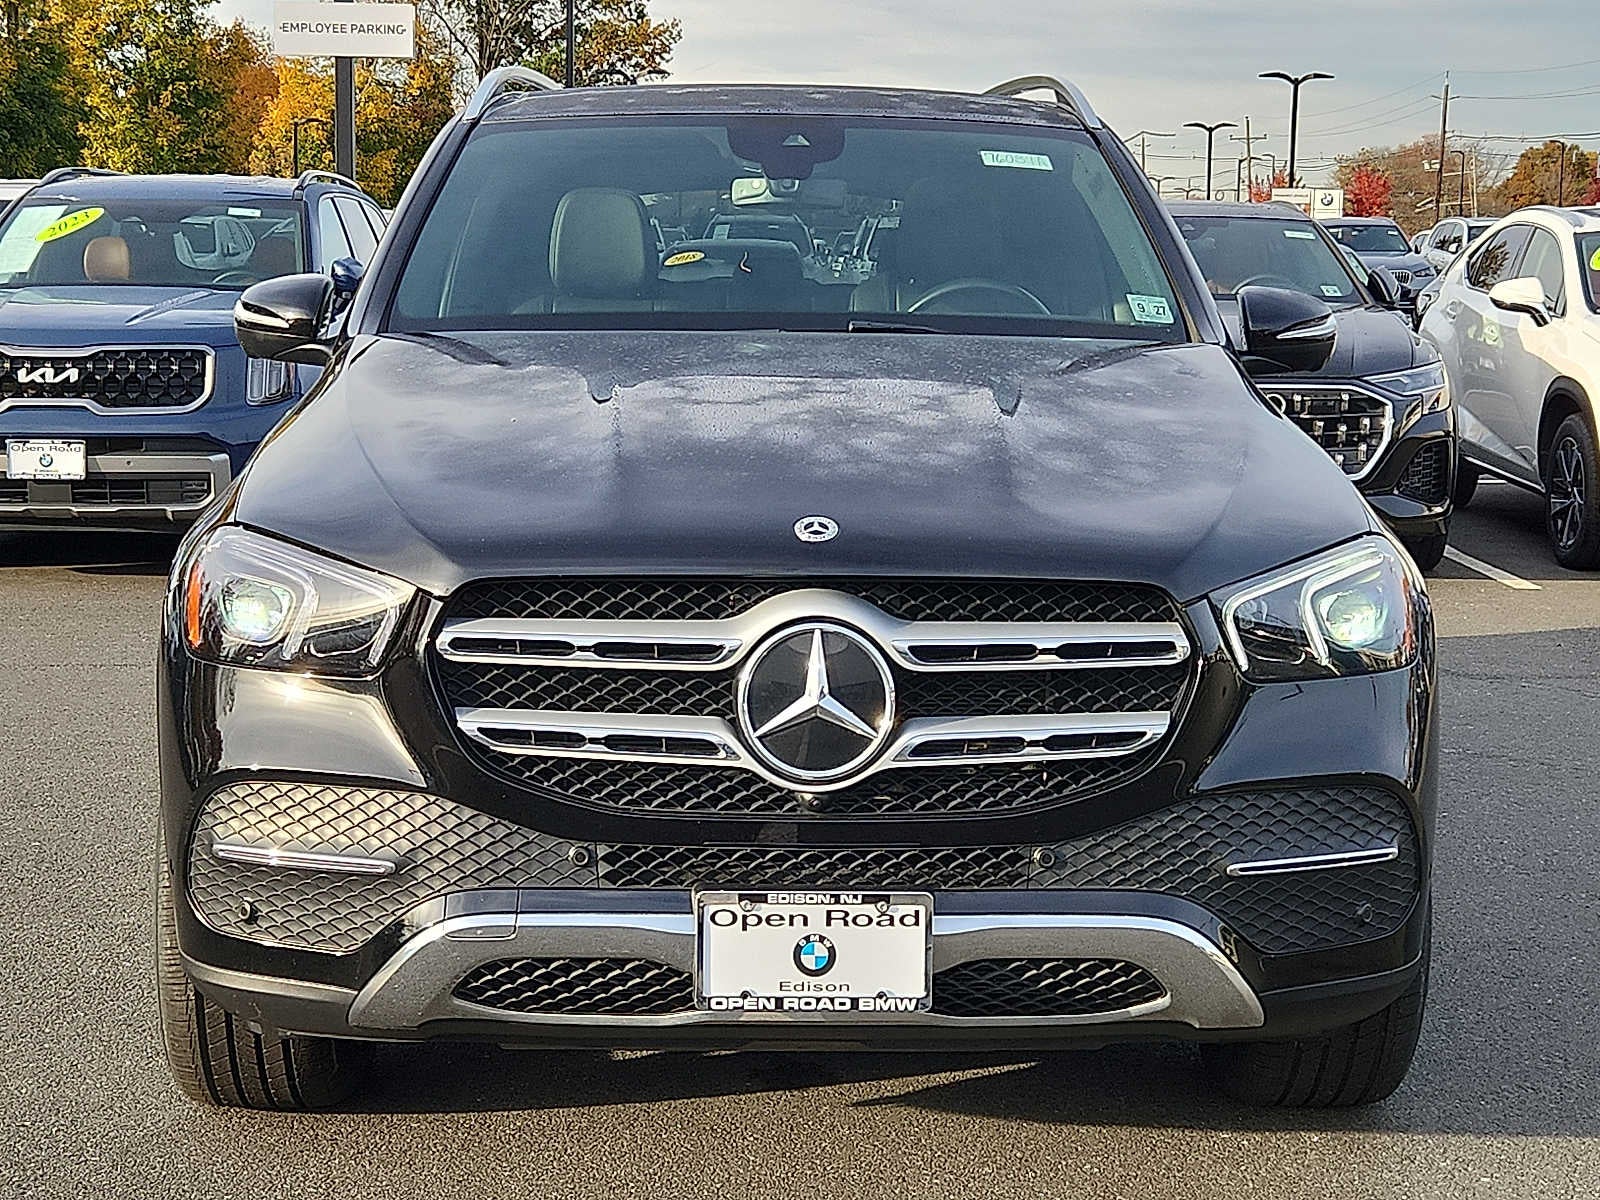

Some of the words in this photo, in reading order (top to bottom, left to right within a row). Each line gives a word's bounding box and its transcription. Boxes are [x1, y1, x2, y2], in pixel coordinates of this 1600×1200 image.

[282, 22, 348, 34] EMPLOYEE
[350, 23, 405, 35] PARKING
[47, 211, 90, 238] 2023
[1137, 303, 1146, 314] 9
[1153, 305, 1166, 316] 27
[11, 444, 45, 453] Open
[49, 445, 81, 453] Road
[840, 894, 863, 905] NJ
[709, 908, 809, 932] Open
[825, 909, 920, 927] Road
[799, 934, 833, 948] BMW
[779, 981, 850, 993] Edison
[710, 997, 779, 1011] OPEN
[783, 997, 851, 1011] ROAD
[858, 997, 917, 1011] BMW
